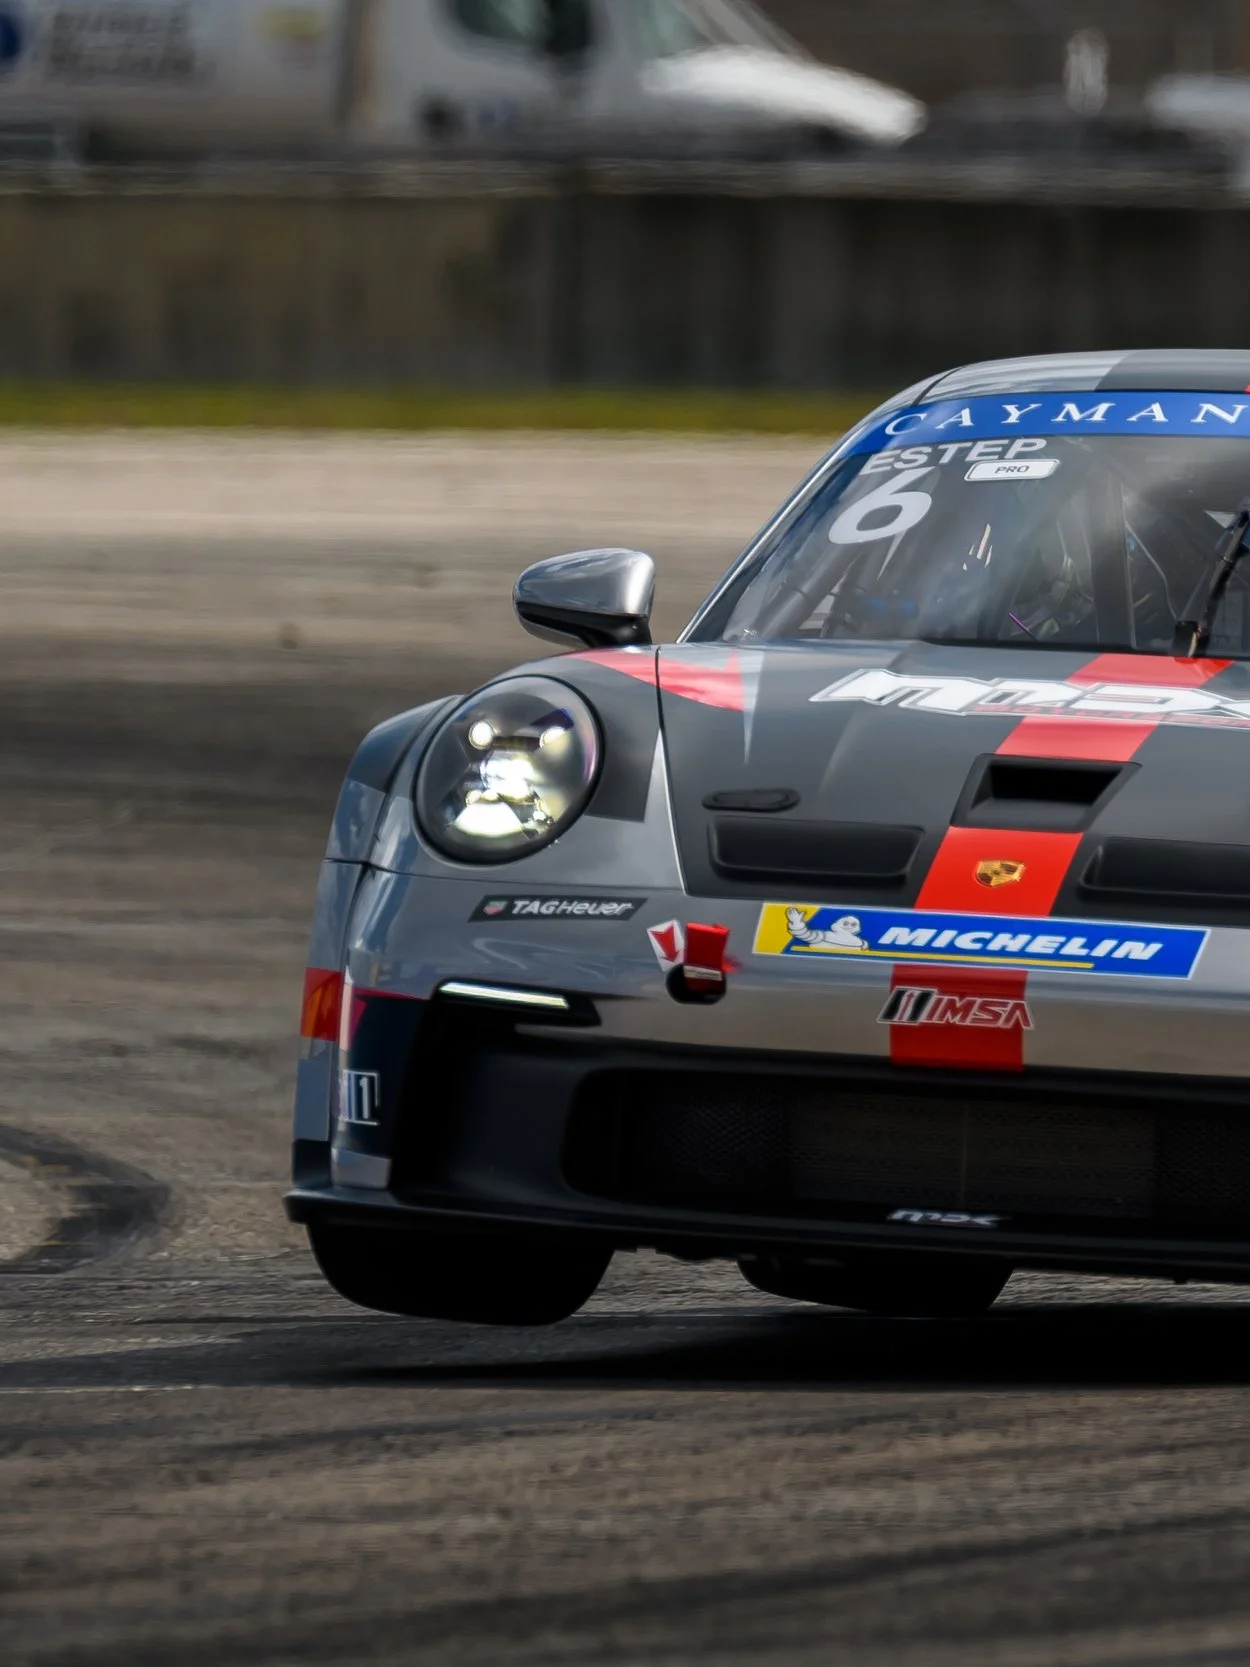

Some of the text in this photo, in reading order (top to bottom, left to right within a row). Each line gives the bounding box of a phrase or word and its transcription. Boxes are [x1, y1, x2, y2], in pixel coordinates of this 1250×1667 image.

[884, 402, 1249, 436] CAYMAN
[859, 438, 1048, 475] ESTEP
[994, 464, 1029, 474] PRO
[828, 466, 936, 545] 6
[877, 926, 1164, 961] MICHELIN
[925, 996, 1033, 1029] IMSA
